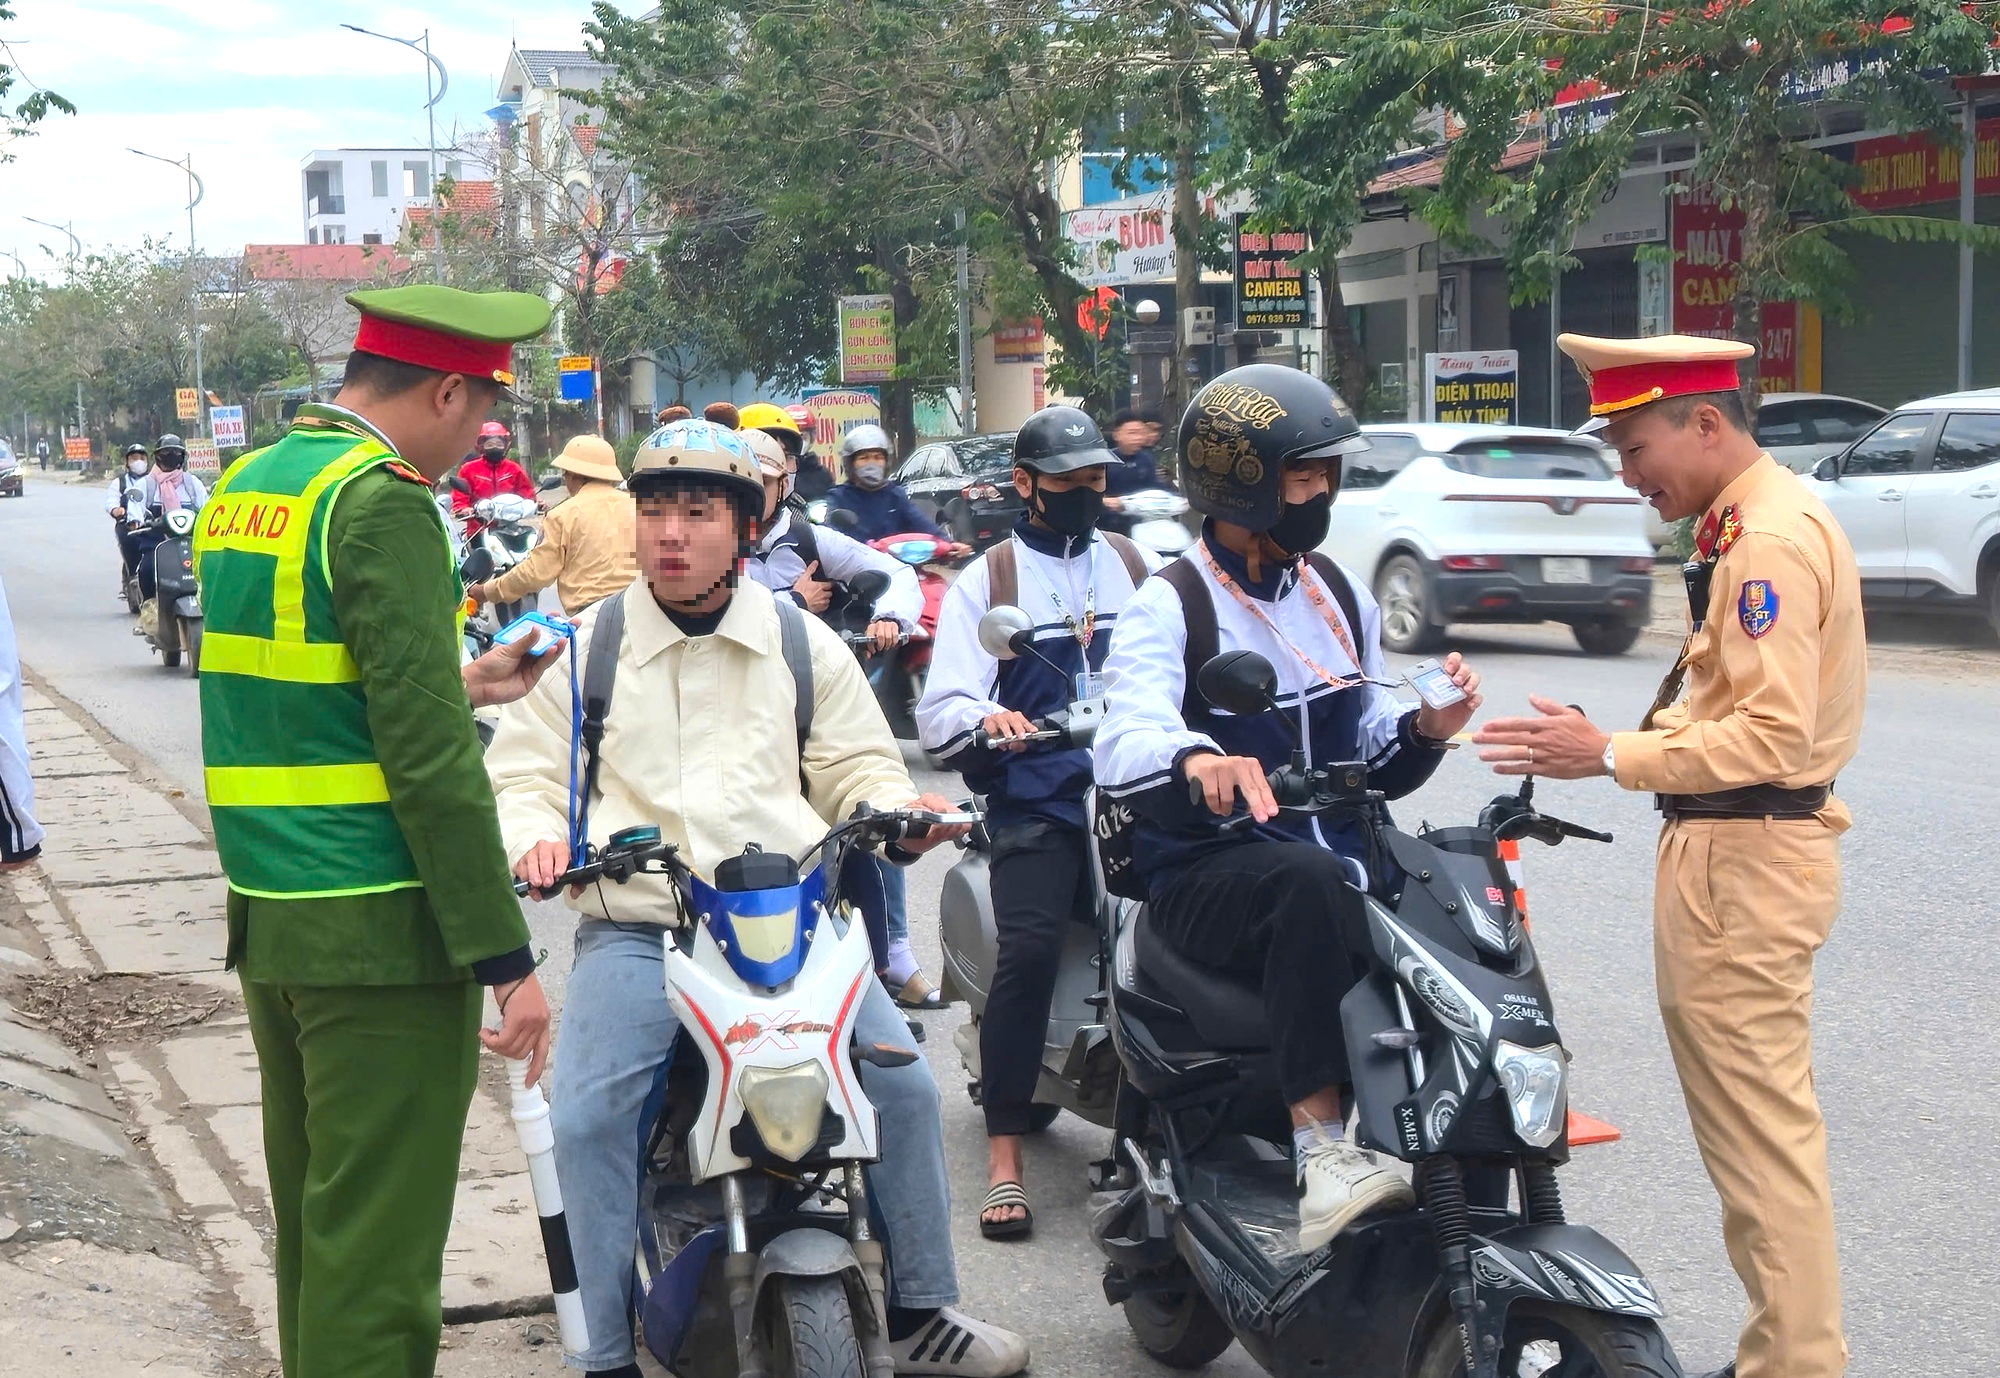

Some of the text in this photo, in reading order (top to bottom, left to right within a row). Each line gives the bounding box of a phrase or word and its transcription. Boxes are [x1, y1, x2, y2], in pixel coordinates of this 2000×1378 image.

[1119, 204, 1165, 250] BÚN
[1270, 232, 1306, 254] THOẠI
[1686, 221, 1732, 265] MÁY
[1244, 257, 1273, 279] MÁY
[1245, 280, 1302, 297] CAMERA
[1246, 315, 1267, 325] 0974
[1435, 381, 1515, 406] ĐIỆN THOẠI
[1441, 405, 1509, 425] MÁY TÍNH
[816, 412, 836, 445] ÚN
[1495, 1002, 1545, 1020] X-MEN
